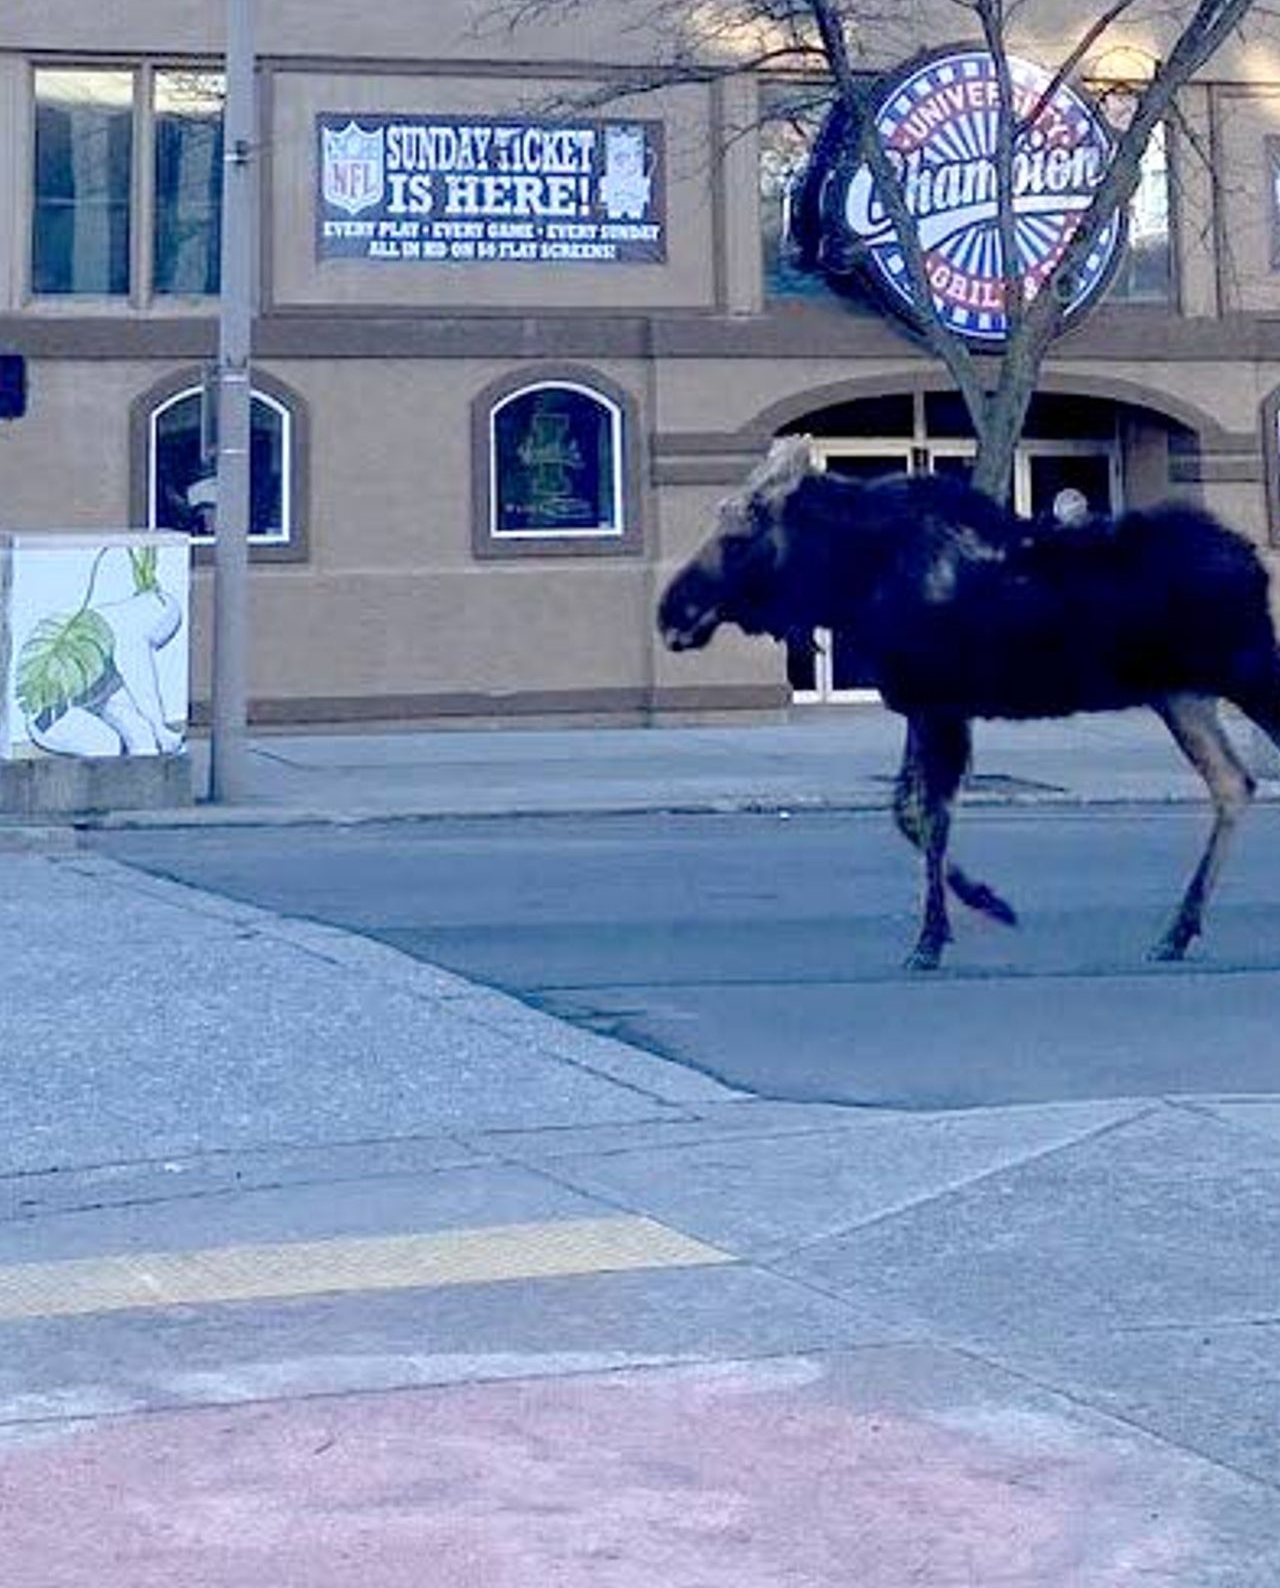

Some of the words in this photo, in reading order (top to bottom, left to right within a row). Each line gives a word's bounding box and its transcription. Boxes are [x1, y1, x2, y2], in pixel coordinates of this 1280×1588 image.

[387, 126, 490, 171] SUNDAY
[494, 127, 595, 173] TICKET
[333, 162, 373, 197] NFL
[387, 174, 433, 214] IS
[445, 175, 590, 216] HERE!
[930, 265, 1008, 307] GRIL
